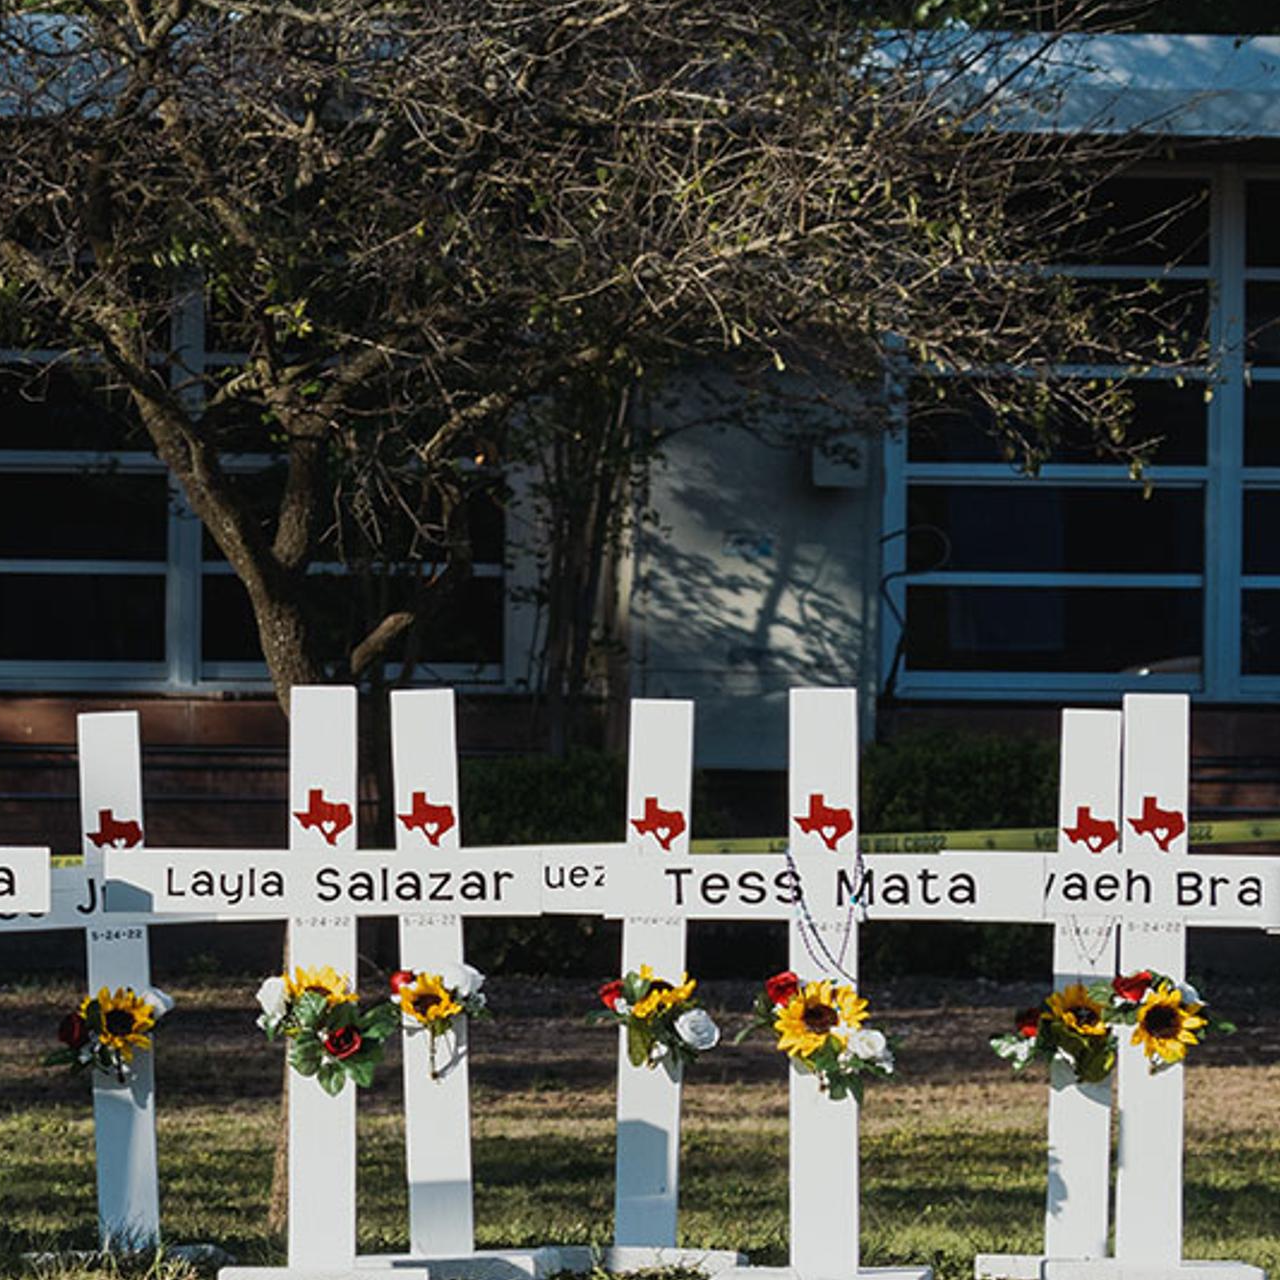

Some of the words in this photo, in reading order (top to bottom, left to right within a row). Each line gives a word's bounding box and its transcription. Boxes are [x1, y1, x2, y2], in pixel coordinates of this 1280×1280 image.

[167, 867, 284, 904] Layla
[316, 869, 513, 901] Salazar
[665, 868, 802, 906] Tess
[836, 870, 976, 906] Mata
[91, 929, 143, 941] 5-24-22
